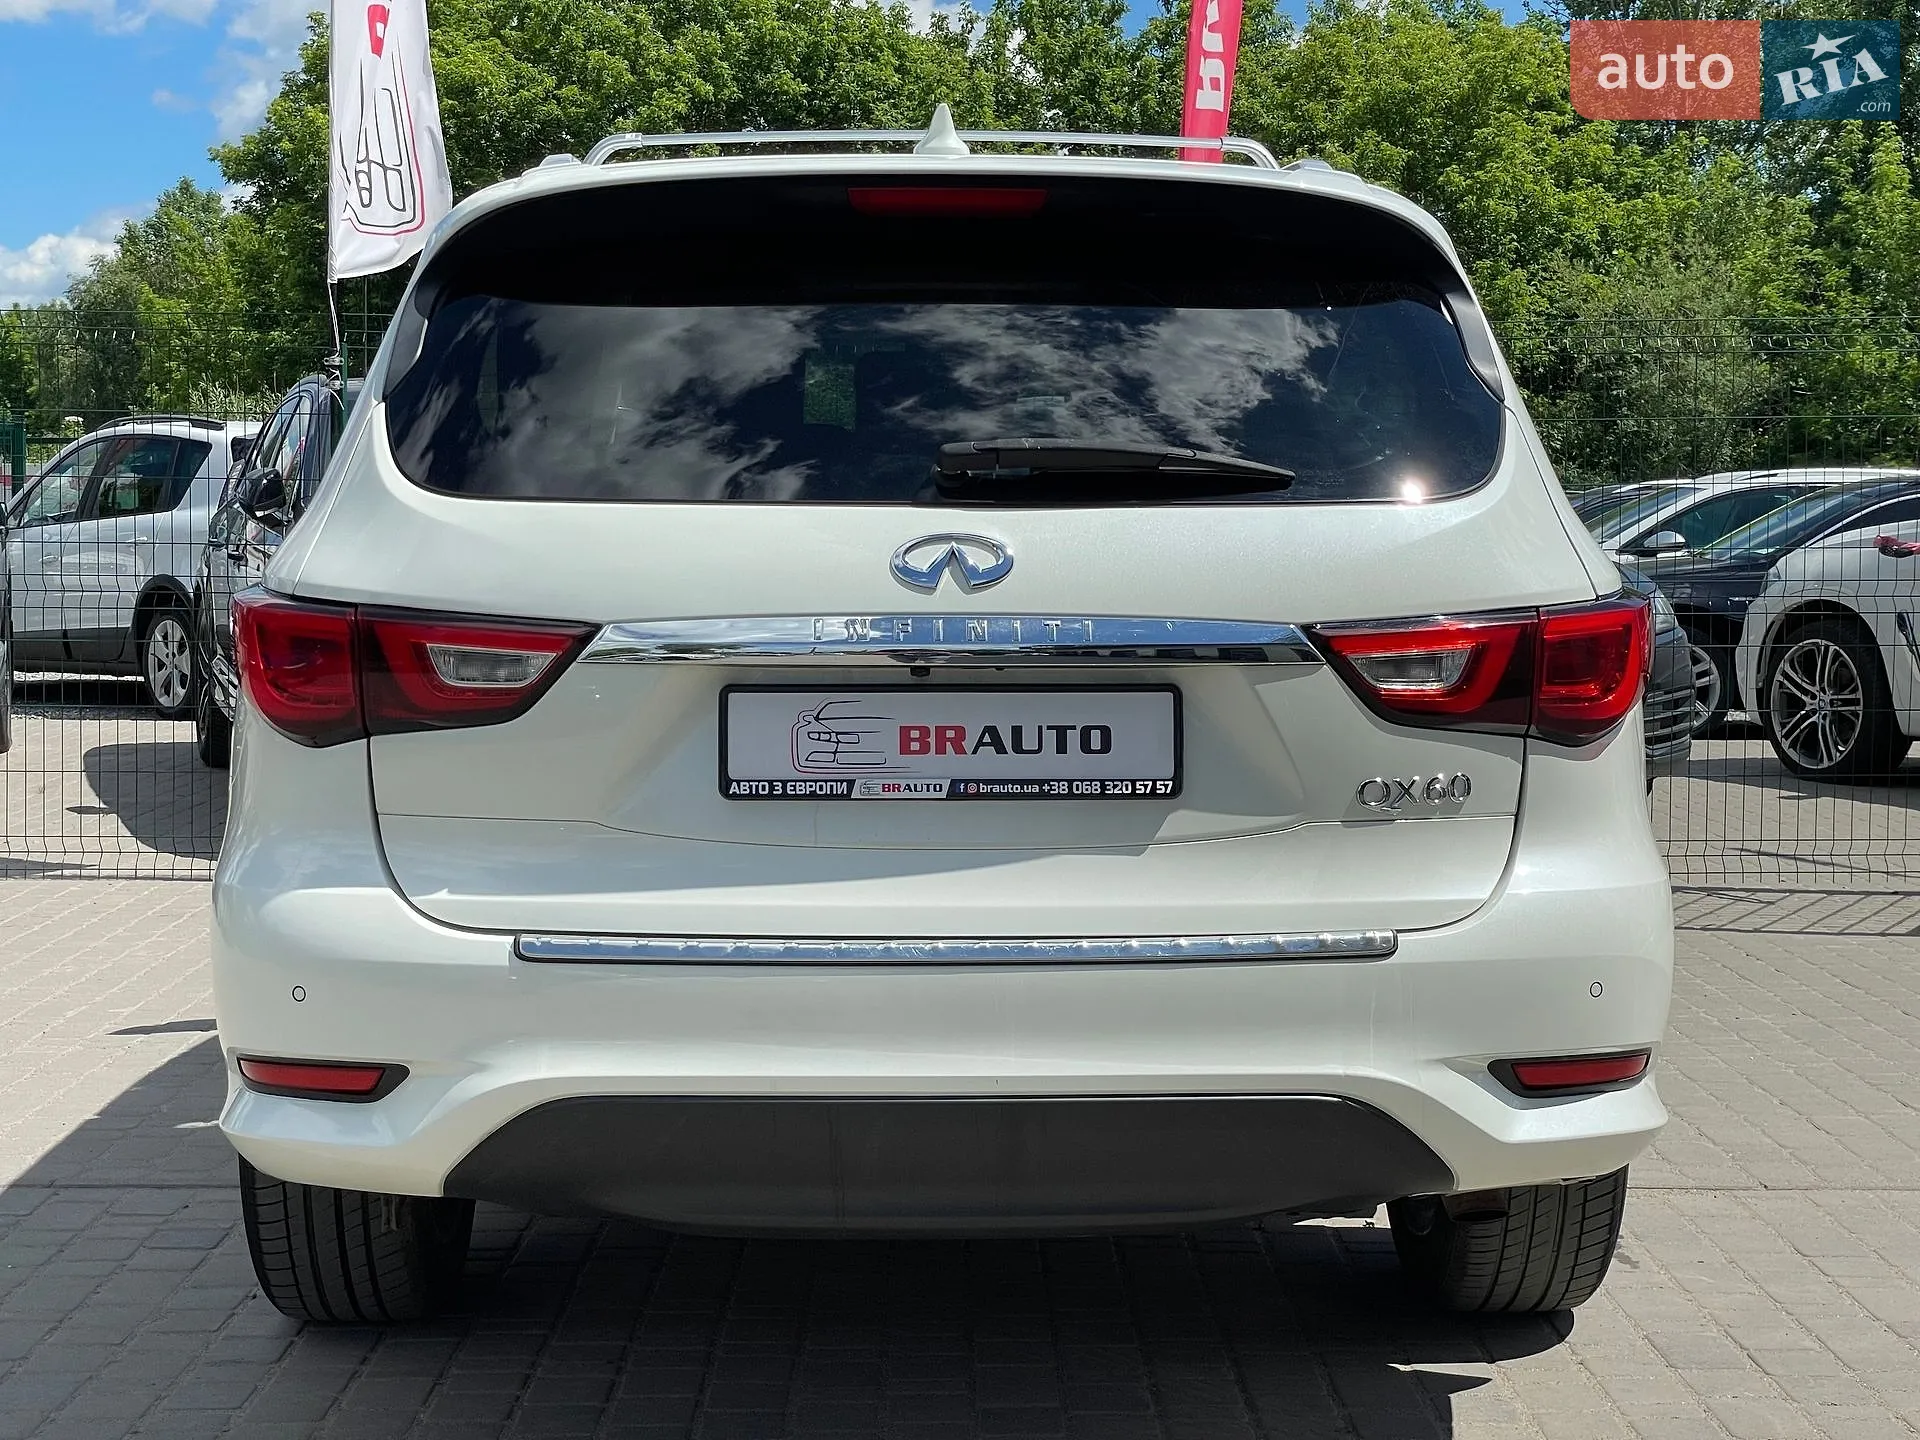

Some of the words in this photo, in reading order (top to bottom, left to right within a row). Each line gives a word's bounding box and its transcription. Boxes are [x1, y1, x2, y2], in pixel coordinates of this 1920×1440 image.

[812, 617, 1093, 642] INFINITI
[898, 724, 1112, 755] BRAUTO
[729, 781, 769, 795] АВТО
[786, 781, 848, 795] ЄВРОПИ
[881, 783, 943, 793] BRAUTO
[979, 783, 1040, 793] brauto.ua
[1042, 781, 1069, 794] +38
[1072, 781, 1101, 794] 068
[1104, 781, 1132, 794] 320
[1135, 781, 1153, 794] 57
[1156, 781, 1173, 794] 57
